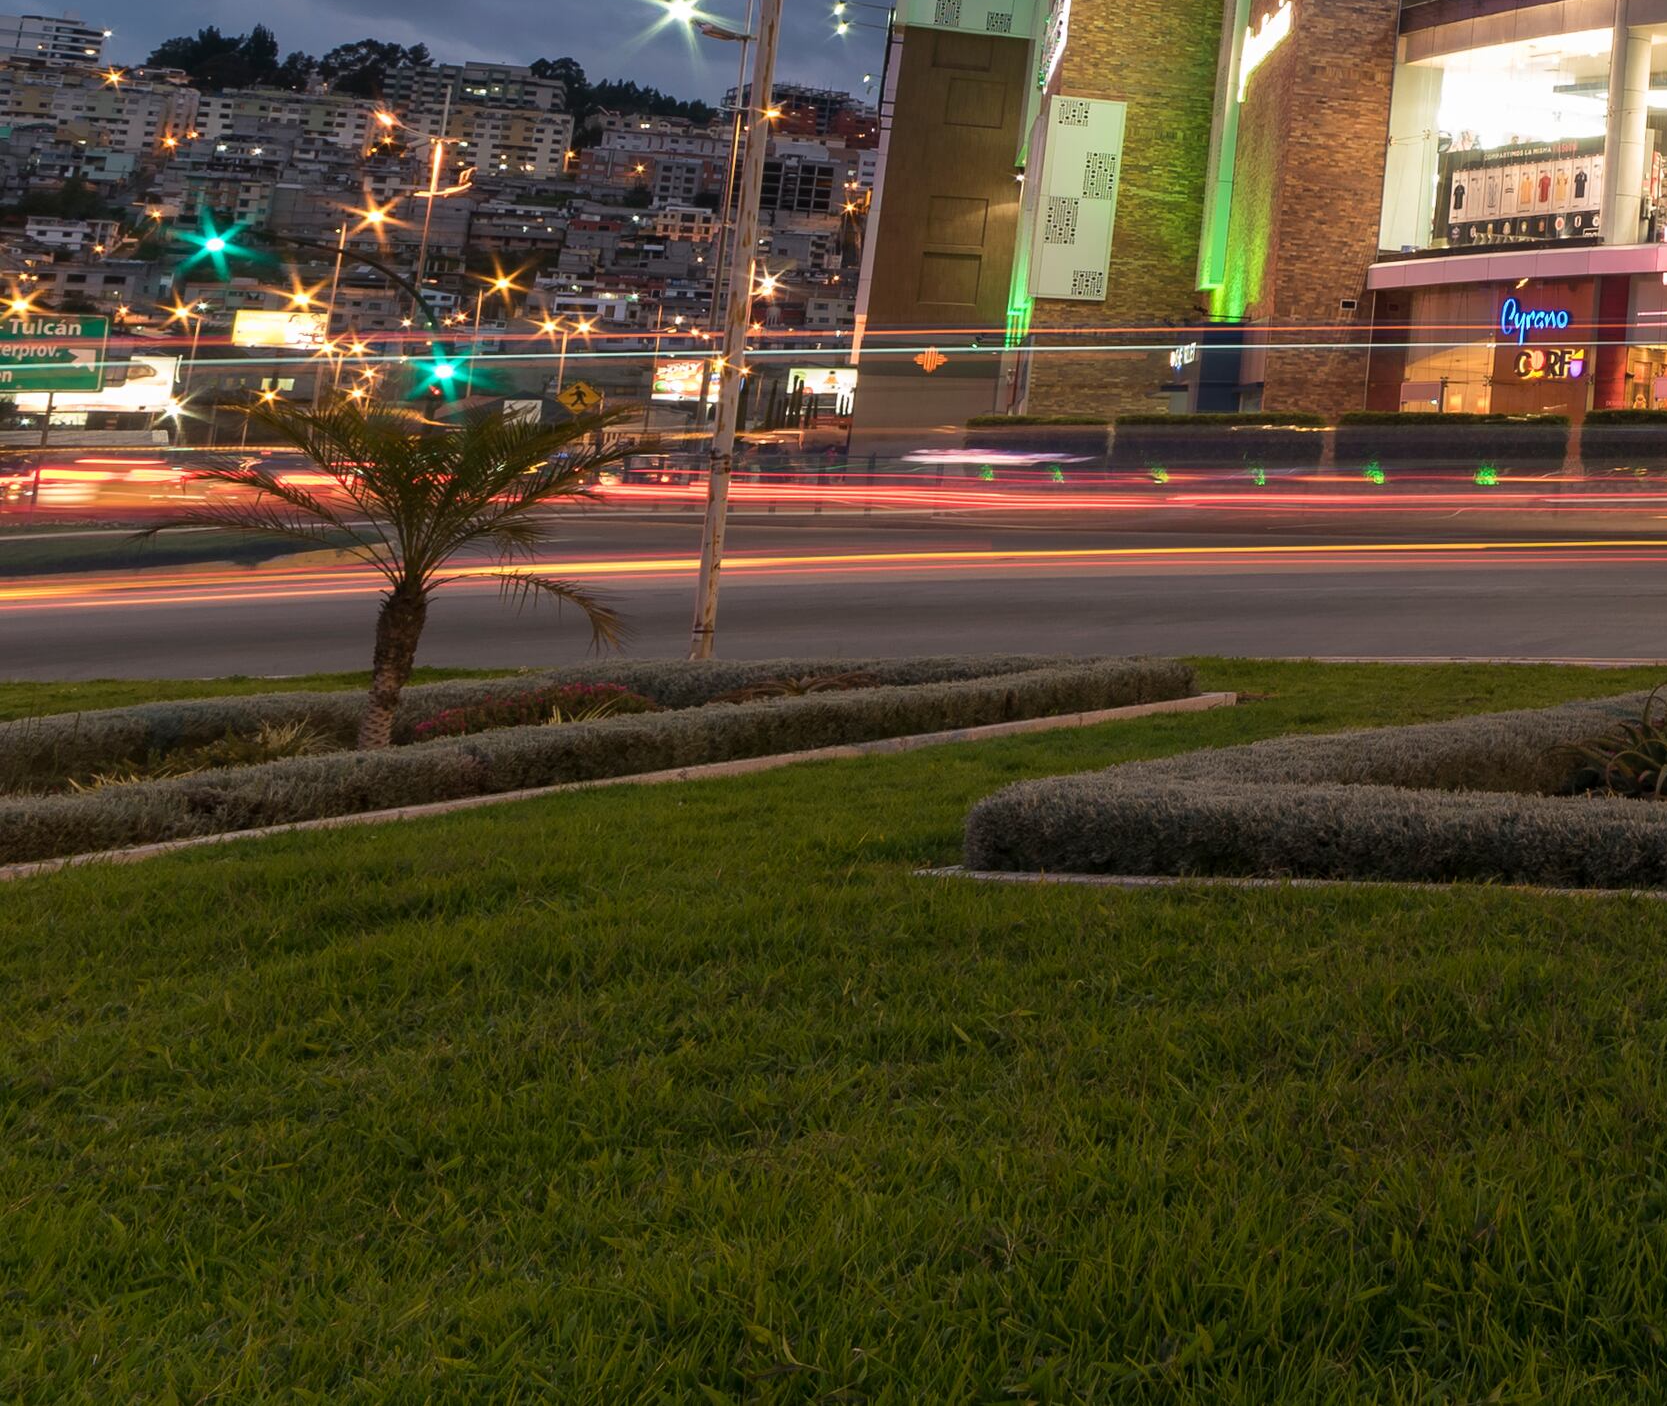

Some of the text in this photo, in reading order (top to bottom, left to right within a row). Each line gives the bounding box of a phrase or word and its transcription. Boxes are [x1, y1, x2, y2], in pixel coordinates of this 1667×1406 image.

[8, 318, 82, 336] Tulcán
[1501, 298, 1569, 346] Cyrano
[0, 344, 61, 361] erprov.
